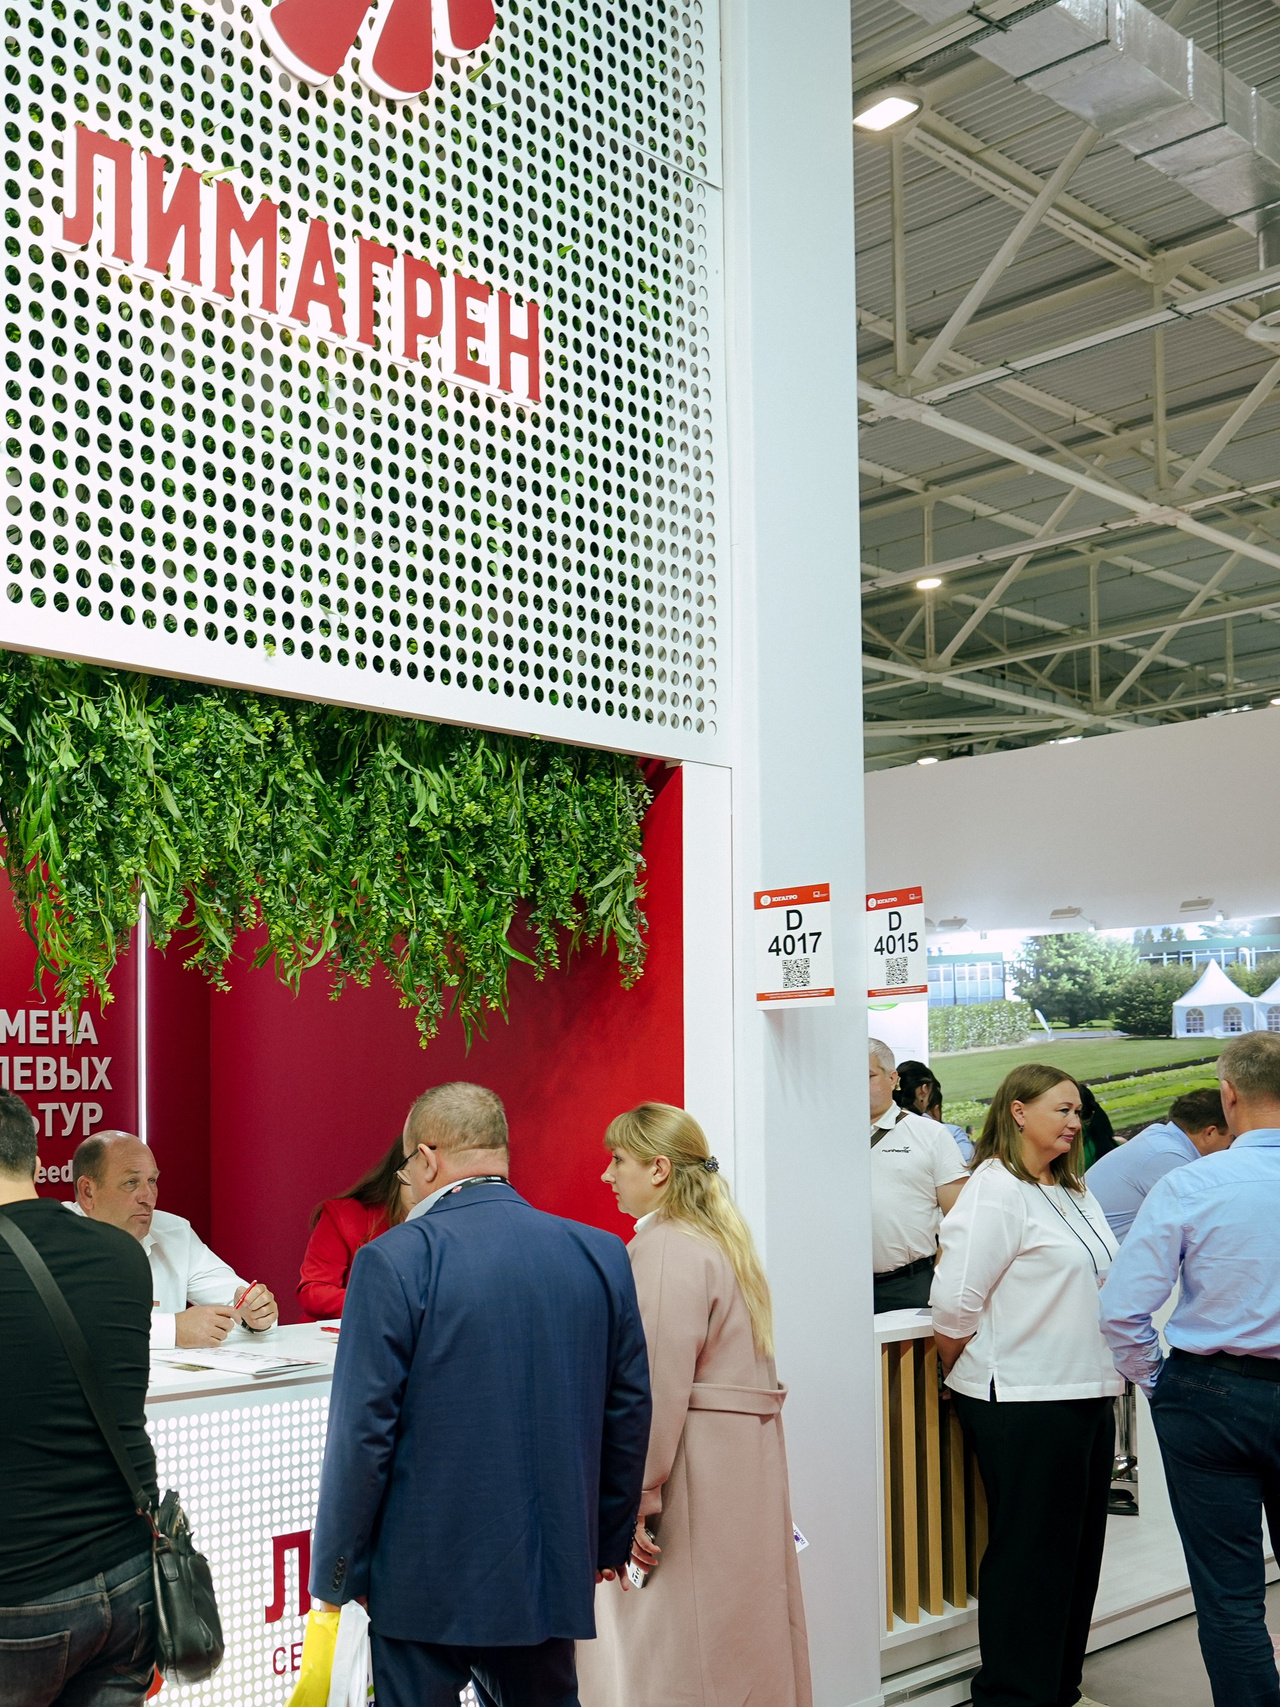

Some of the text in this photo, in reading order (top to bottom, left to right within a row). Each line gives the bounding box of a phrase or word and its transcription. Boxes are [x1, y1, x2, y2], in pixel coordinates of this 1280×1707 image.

[58, 122, 541, 403] ЛИМАГРЕН
[786, 909, 803, 931] D
[888, 911, 902, 931] D
[768, 931, 822, 956] 4017
[874, 932, 918, 955] 4015
